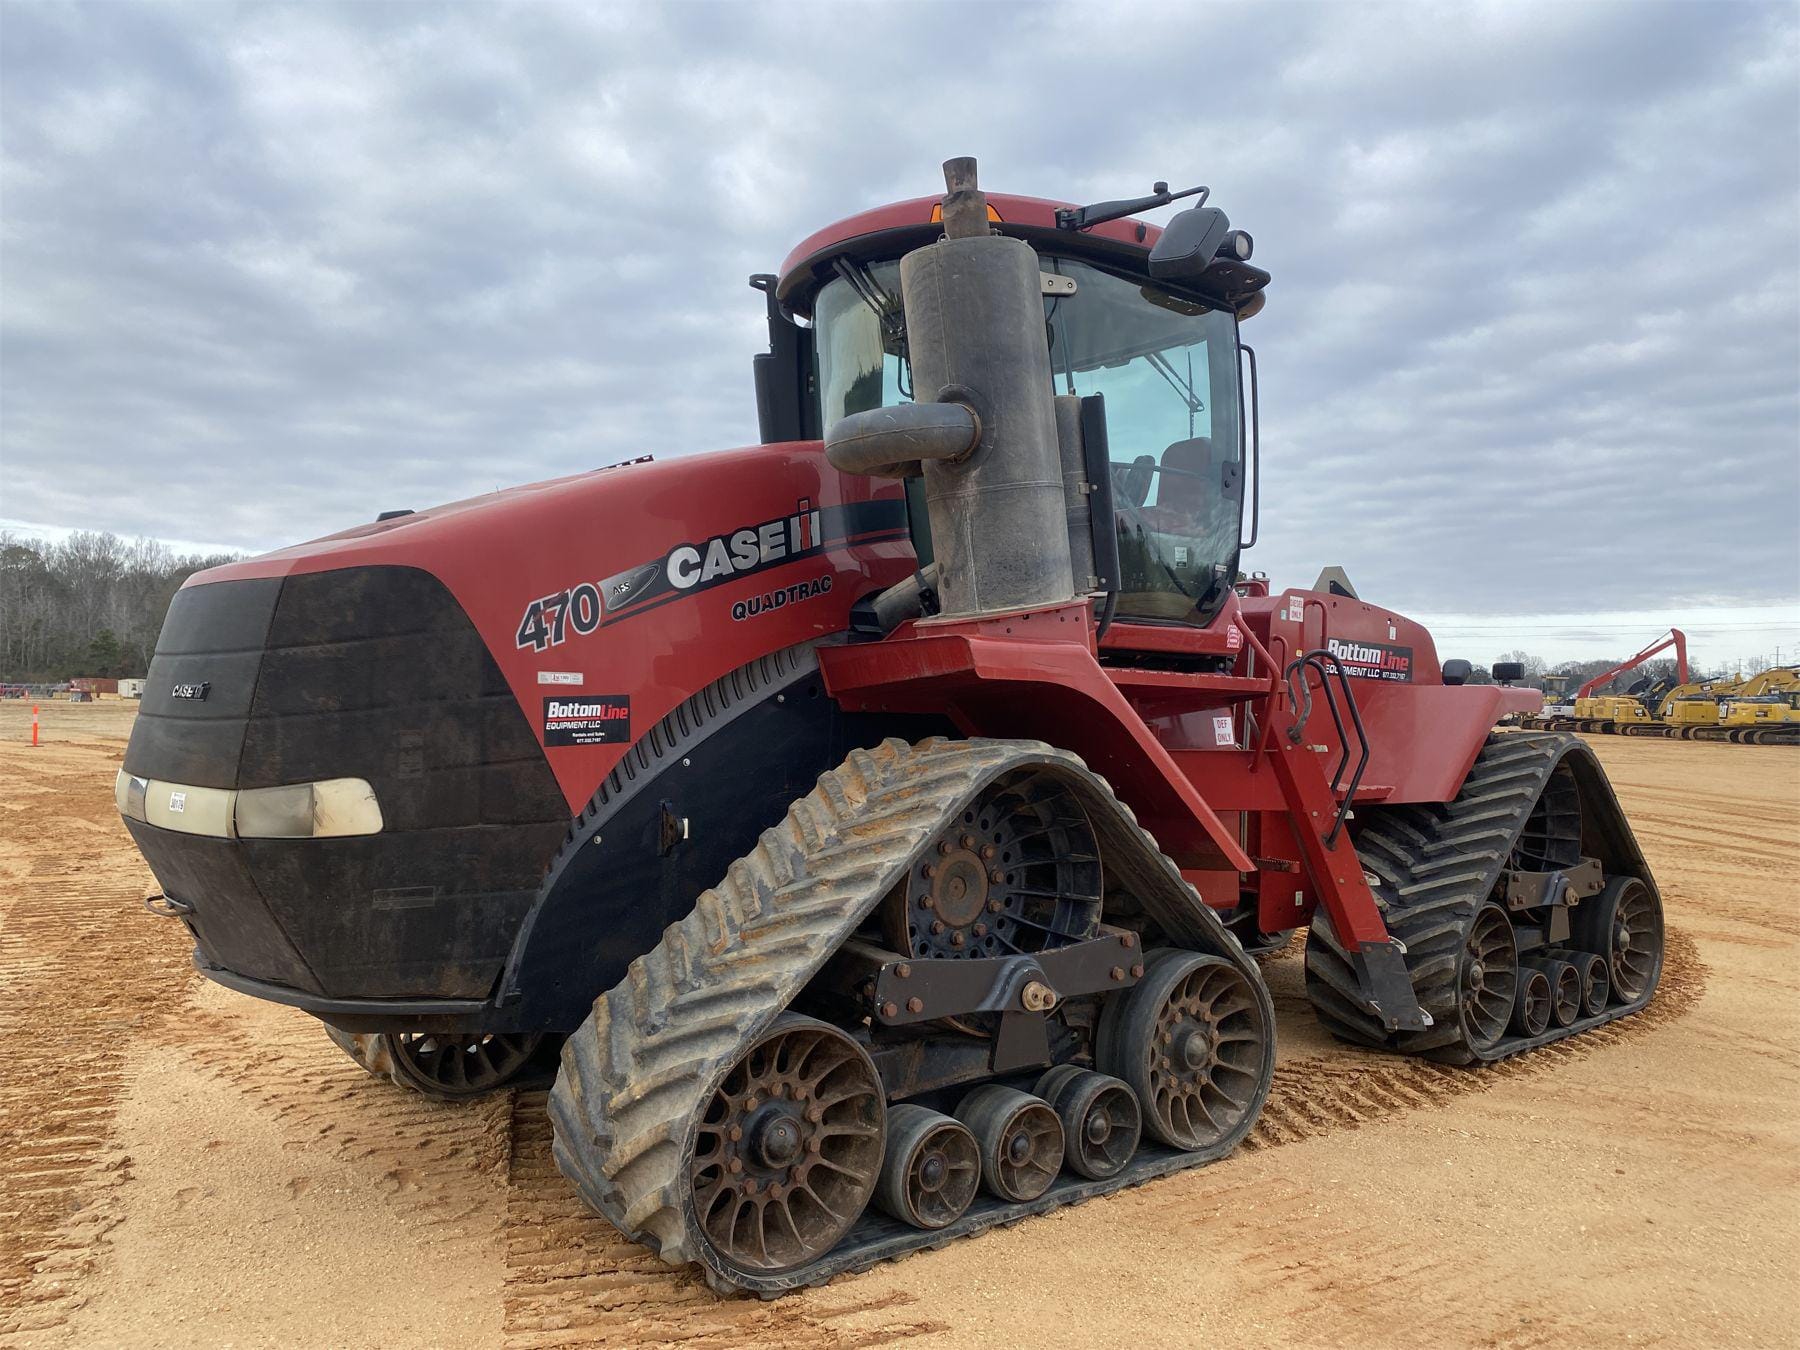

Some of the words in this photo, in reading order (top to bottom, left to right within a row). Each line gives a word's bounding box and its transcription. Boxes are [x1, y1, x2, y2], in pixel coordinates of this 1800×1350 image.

[666, 520, 786, 589] CASE
[612, 581, 631, 596] AFS
[731, 575, 833, 622] QUADTRAC
[515, 582, 601, 653] 470
[172, 684, 193, 698] CASE
[545, 721, 588, 730] EQUIPMENT
[588, 720, 601, 728] LLC
[1217, 719, 1227, 729] DEF
